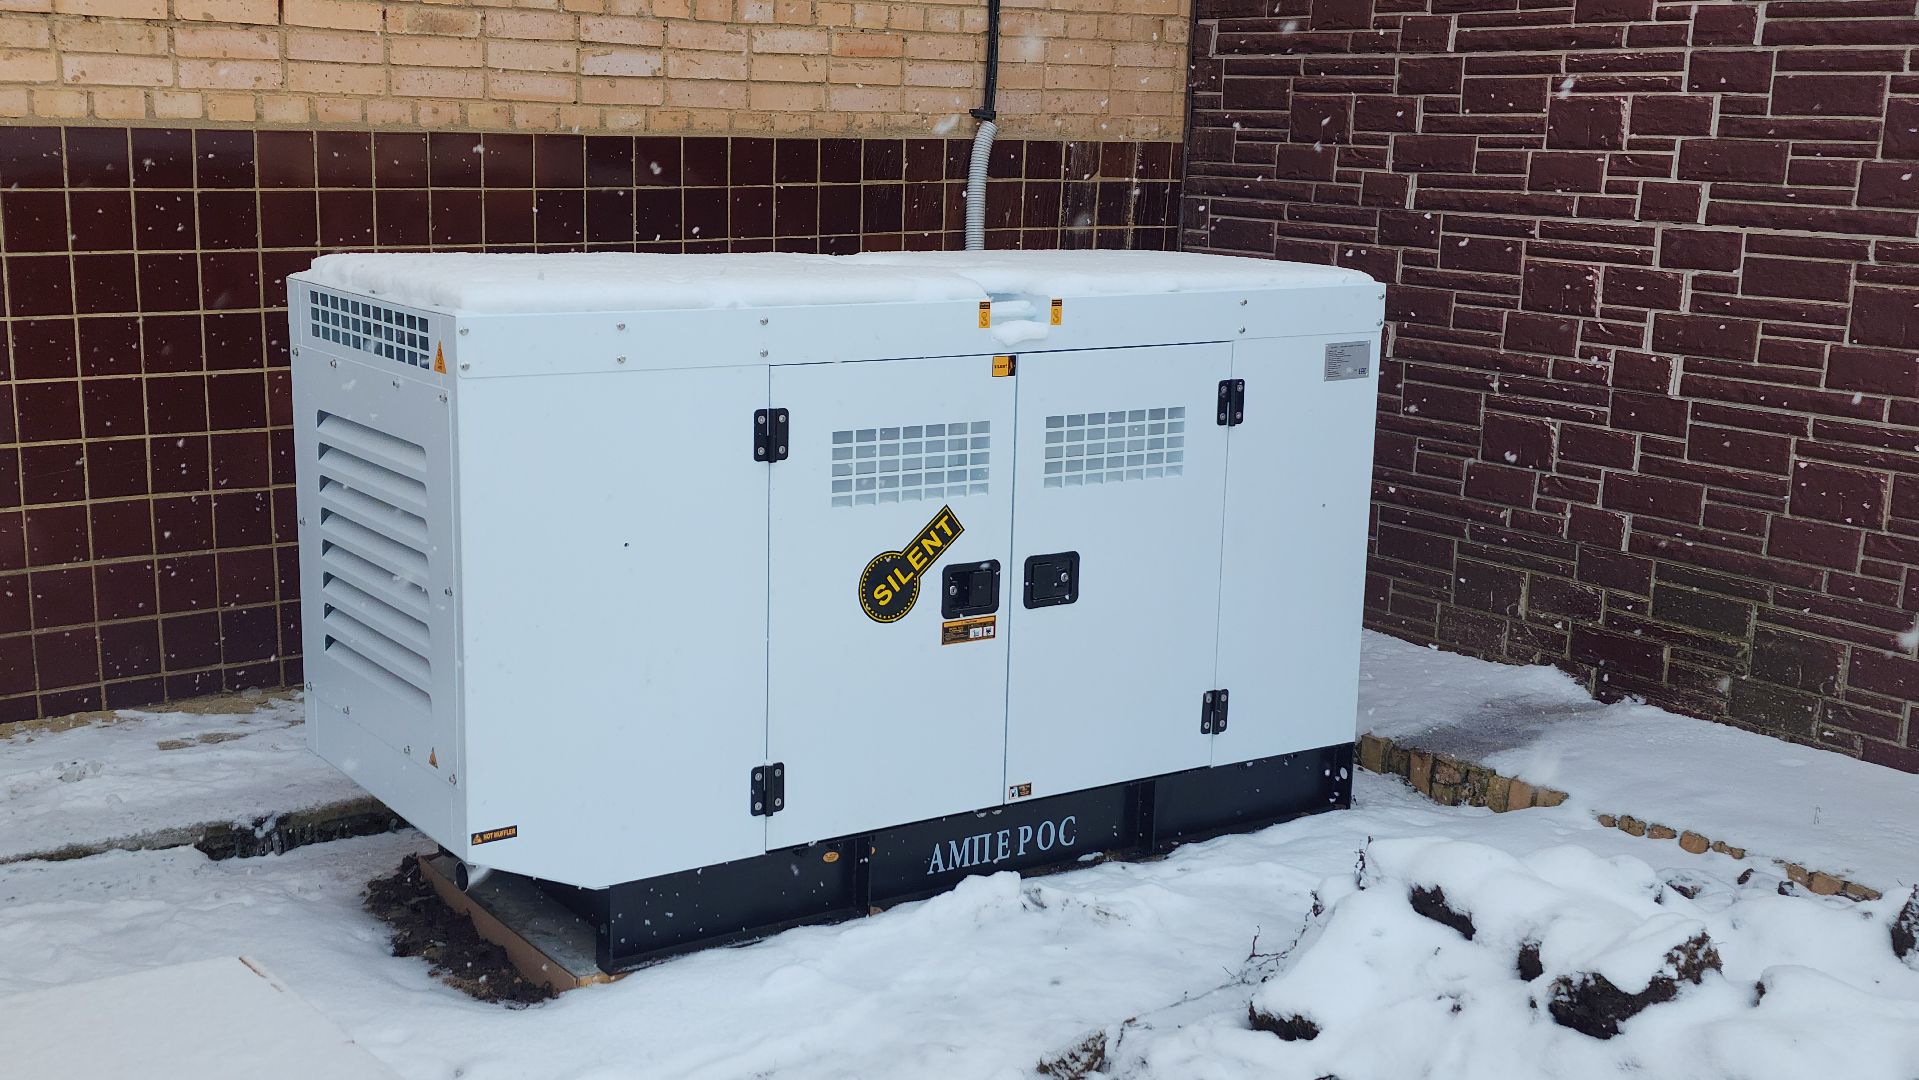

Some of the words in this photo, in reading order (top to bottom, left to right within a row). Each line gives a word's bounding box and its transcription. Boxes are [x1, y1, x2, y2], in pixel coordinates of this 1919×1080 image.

[873, 515, 954, 606] SILENT
[483, 832, 493, 840] HOT
[494, 828, 516, 838] MUFFLER
